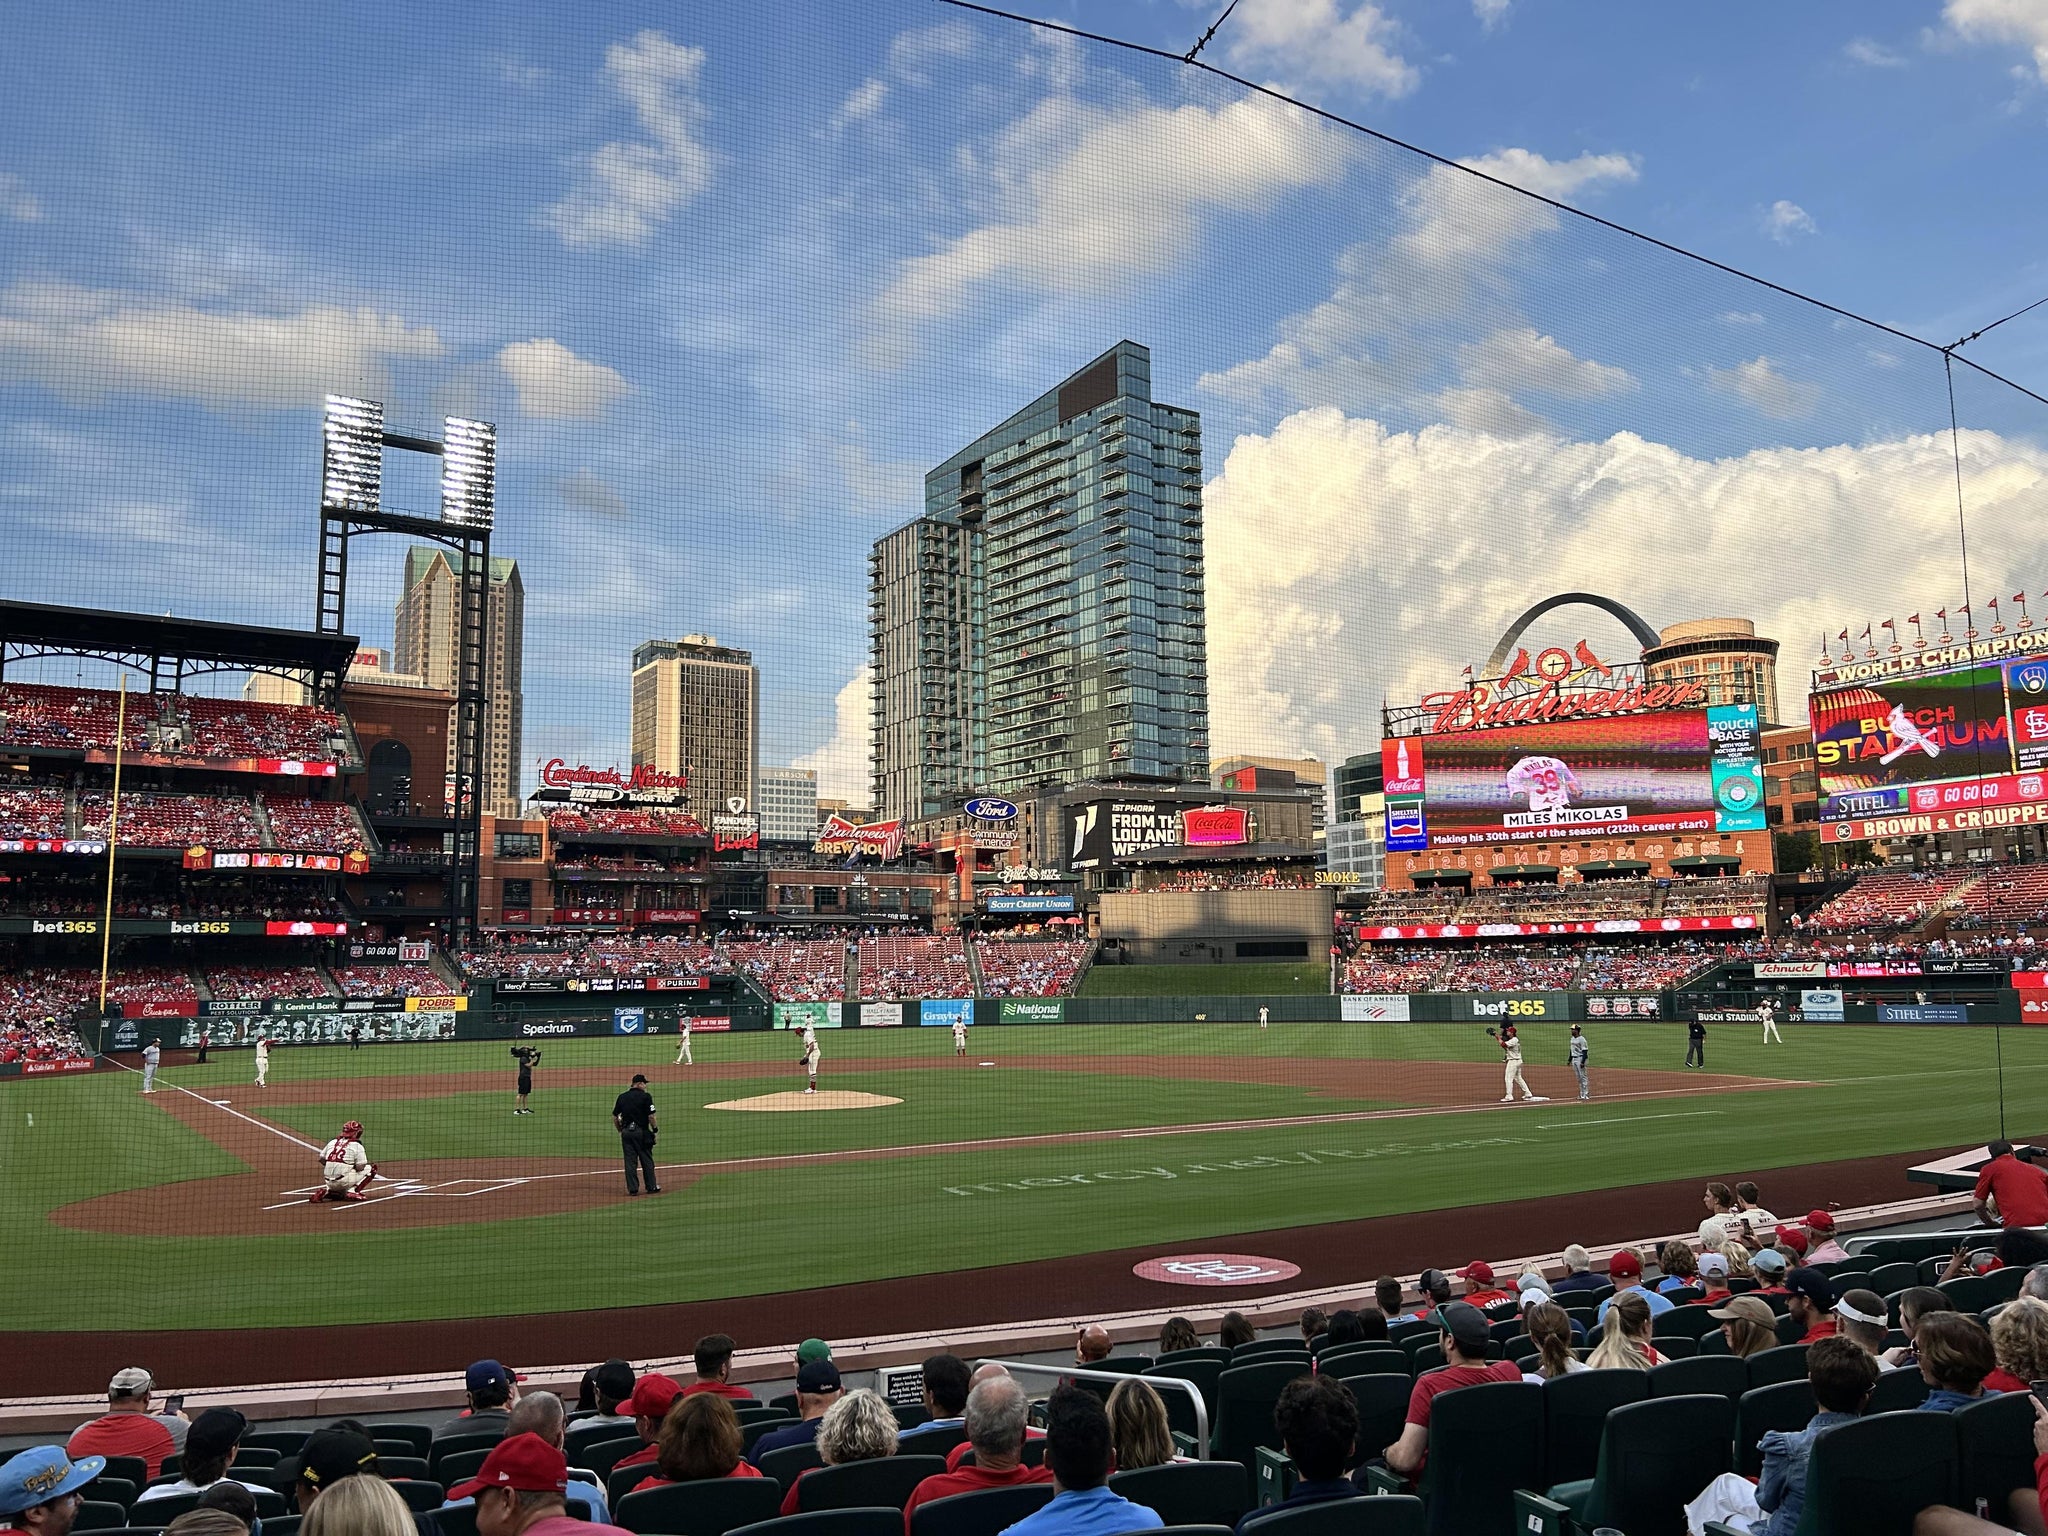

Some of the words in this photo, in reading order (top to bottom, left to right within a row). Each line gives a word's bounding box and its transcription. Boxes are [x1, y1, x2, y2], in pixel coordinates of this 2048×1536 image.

[1835, 655, 1916, 682] WORLD
[1421, 676, 1702, 733] Budweiser
[1711, 718, 1754, 730] TOUCH
[1718, 730, 1750, 741] BASE
[543, 758, 621, 788] Cardinals
[621, 764, 688, 790] Nation
[774, 771, 808, 779] LARSON
[1385, 778, 1422, 792] Coca-Cola
[1531, 769, 1560, 796] 39
[2023, 783, 2039, 794] 66
[570, 788, 615, 799] HOFFMANN
[629, 793, 675, 803] ROOFTOP
[1920, 796, 1934, 805] 66
[1945, 788, 1960, 802] GO
[1963, 786, 1979, 800] GO
[1982, 783, 1999, 798] GO
[975, 801, 1009, 817] Ford
[1839, 795, 1890, 813] STIFEL
[1391, 809, 1418, 817] SHELTER
[1509, 813, 1551, 826] MILES
[1556, 808, 1623, 823] MIKOLAS
[713, 817, 758, 825] FANDUEL
[1112, 815, 1155, 829] FROM
[1158, 815, 1176, 828] TH
[1194, 816, 1234, 831] Coca-Cola
[1838, 826, 1850, 836] BC
[1864, 816, 1931, 837] BROWN
[1937, 817, 1950, 829] &
[818, 822, 893, 840] Budweise
[969, 828, 1018, 842] Community
[1112, 828, 1144, 842] LOU
[1145, 828, 1175, 842] AND
[1433, 835, 1468, 846] Making
[1469, 833, 1484, 843] his
[1485, 831, 1510, 842] 30th
[1511, 830, 1535, 841] start
[1536, 829, 1548, 839] of
[1549, 827, 1567, 838] the
[1568, 828, 1604, 837] season
[1606, 823, 1640, 837] (212th
[1641, 823, 1678, 833] career
[1678, 819, 1709, 832] start)
[814, 842, 856, 855] BREW
[1112, 843, 1154, 856] WE'R
[214, 853, 250, 868] BIG
[252, 853, 294, 869] MAC
[295, 855, 341, 870] LAND
[1441, 856, 1450, 869] 2
[1457, 856, 1467, 868] 6
[1474, 854, 1484, 867] 9
[1514, 852, 1528, 865] 14
[1537, 851, 1551, 864] 17
[1560, 849, 1579, 863] 20
[1616, 846, 1635, 860] 24
[1645, 845, 1664, 858] 42
[1674, 843, 1693, 857] 45
[1314, 871, 1360, 883] SMOKE
[991, 900, 1015, 909] SCOTT
[1016, 900, 1044, 908] CREDIT
[1046, 900, 1071, 908] UNION
[33, 921, 97, 933] bet365
[171, 921, 230, 933] bet365
[366, 947, 376, 955] GO
[376, 947, 386, 955] GO
[387, 947, 397, 955] GO
[1760, 963, 1819, 973] Schnucks
[1932, 964, 1954, 973] Mercy
[505, 983, 522, 991] Mercy
[419, 998, 456, 1007] DOBBS
[1812, 994, 1831, 1003] Ford
[143, 1004, 180, 1016] Chick-fil-A
[210, 1002, 261, 1010] ROTTLER
[285, 1002, 313, 1010] Central
[315, 1002, 338, 1010] Bank
[614, 1007, 644, 1015] CarShield
[1016, 1003, 1061, 1015] National
[1473, 1000, 1545, 1016] bet365
[1698, 1012, 1724, 1021] BUSCH
[1886, 1008, 1921, 1020] STIFEL
[522, 1023, 574, 1036] Spectrum
